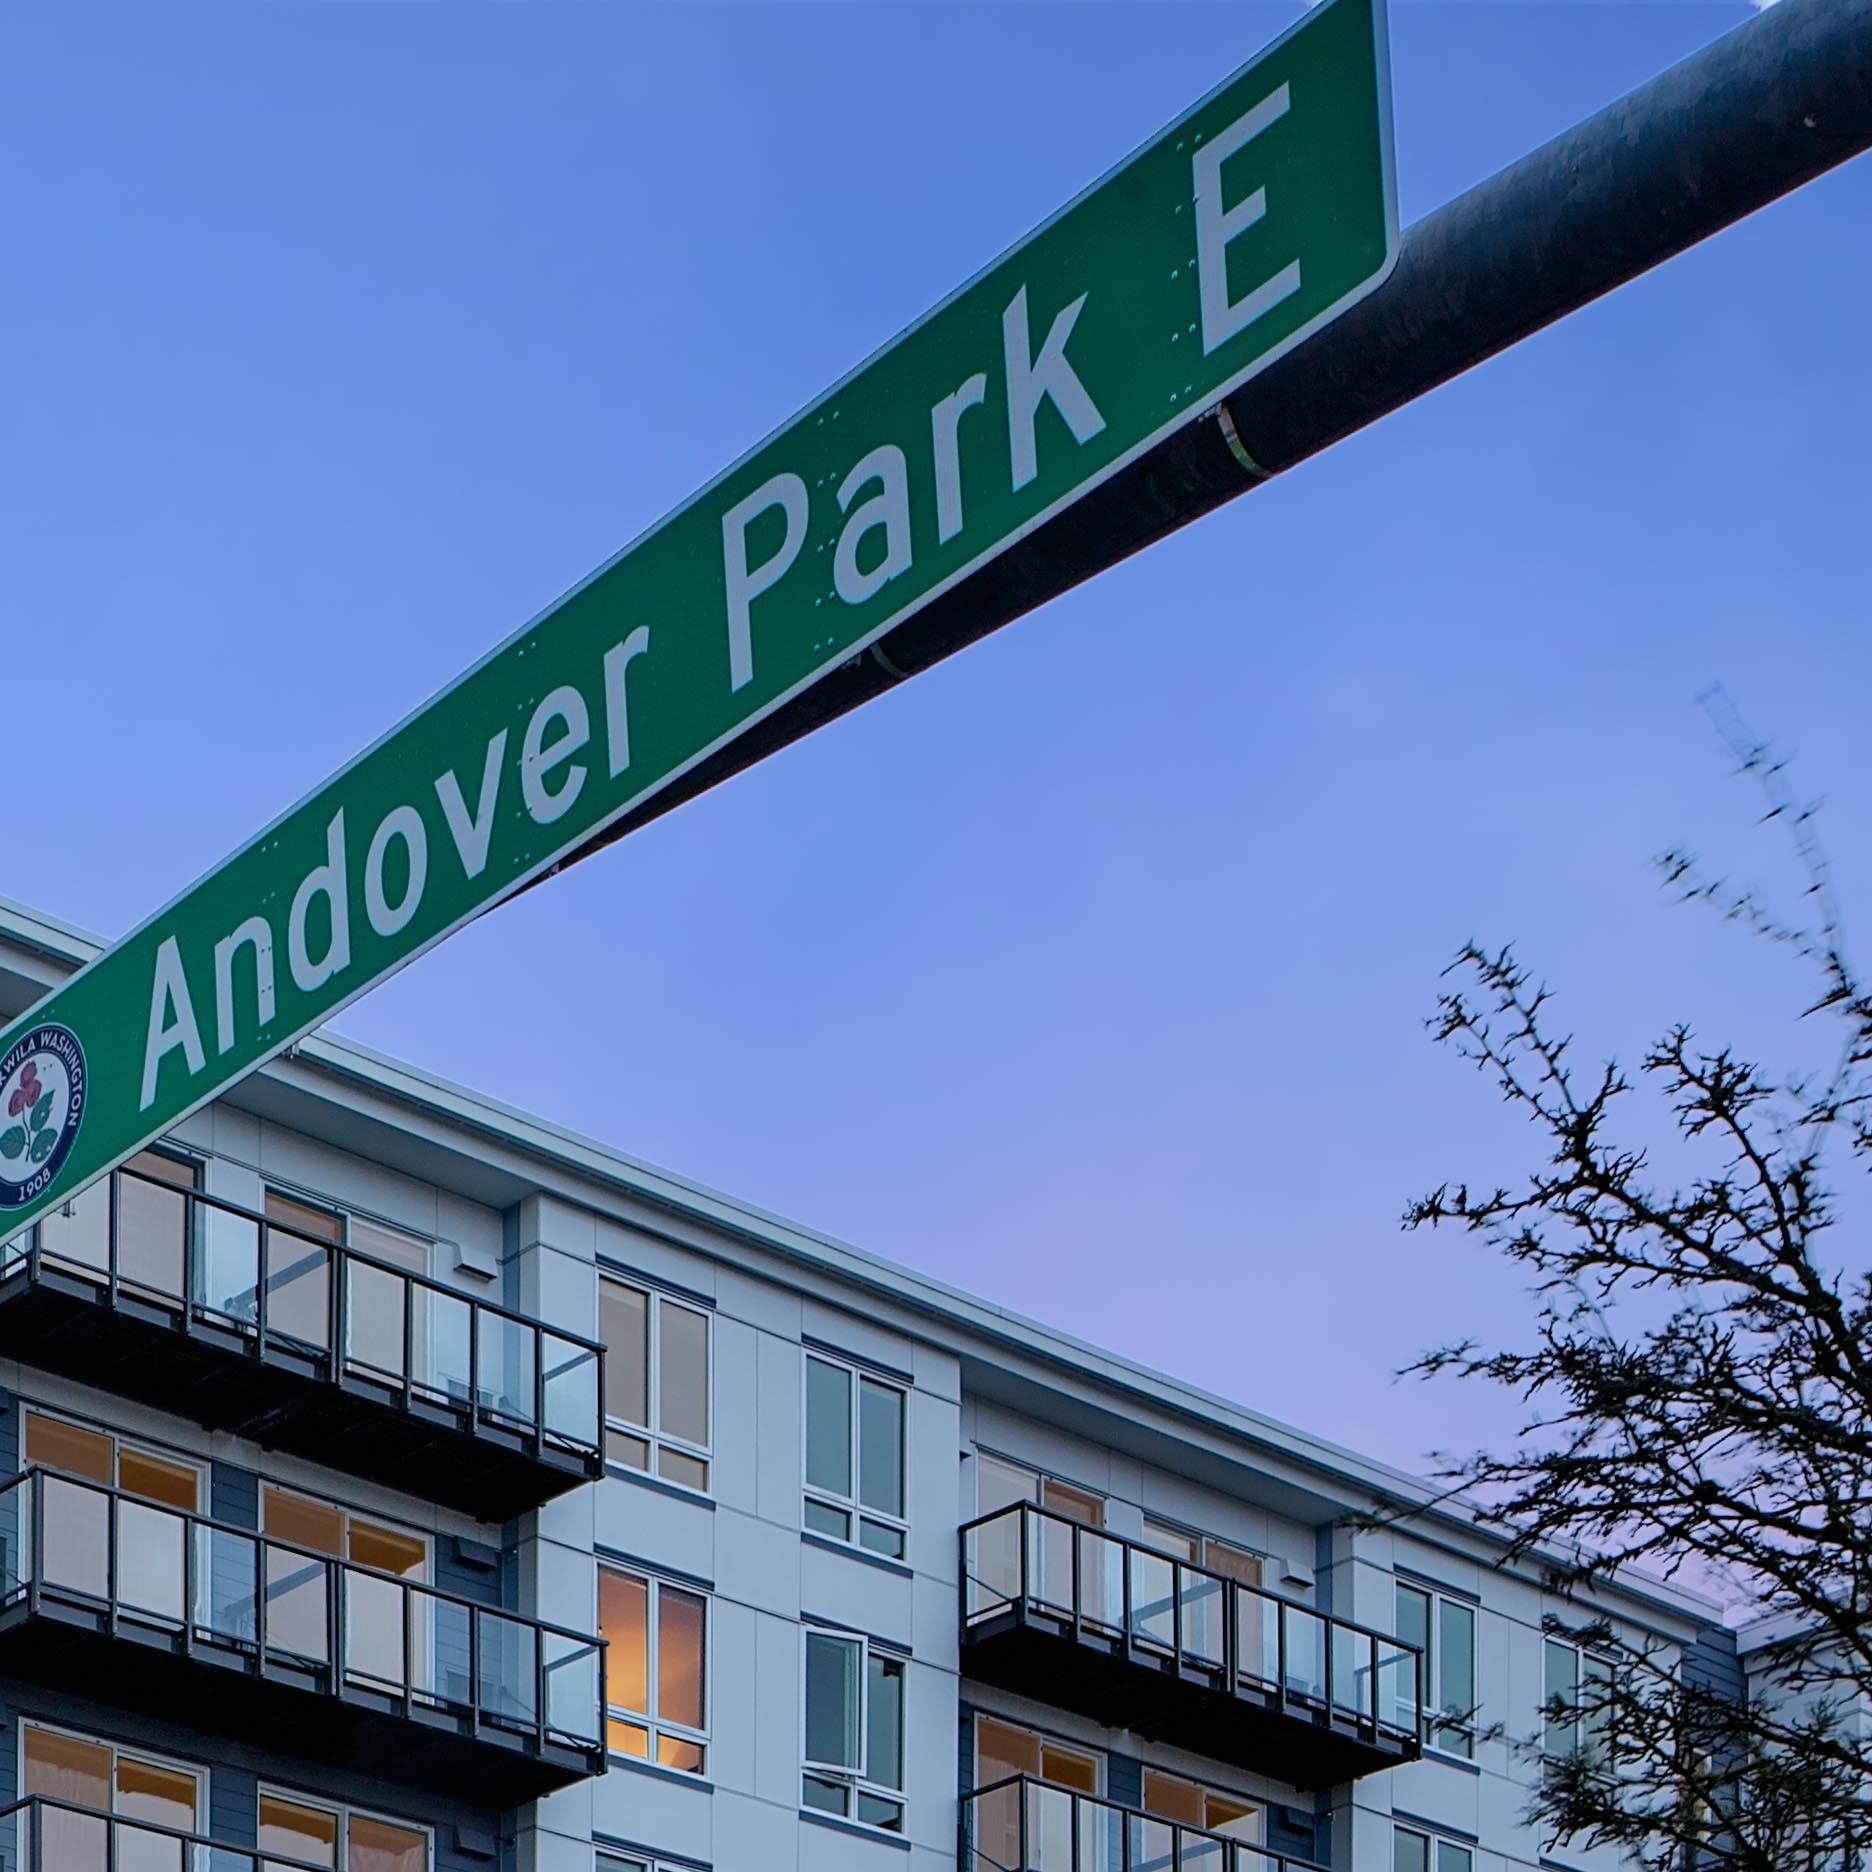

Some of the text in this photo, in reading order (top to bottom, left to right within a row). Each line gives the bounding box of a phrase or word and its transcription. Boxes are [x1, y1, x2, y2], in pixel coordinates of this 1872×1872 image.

[138, 81, 1301, 1111] Andover Park E
[40, 1030, 82, 1127] WASHINGTON
[17, 1166, 51, 1202] 1908
